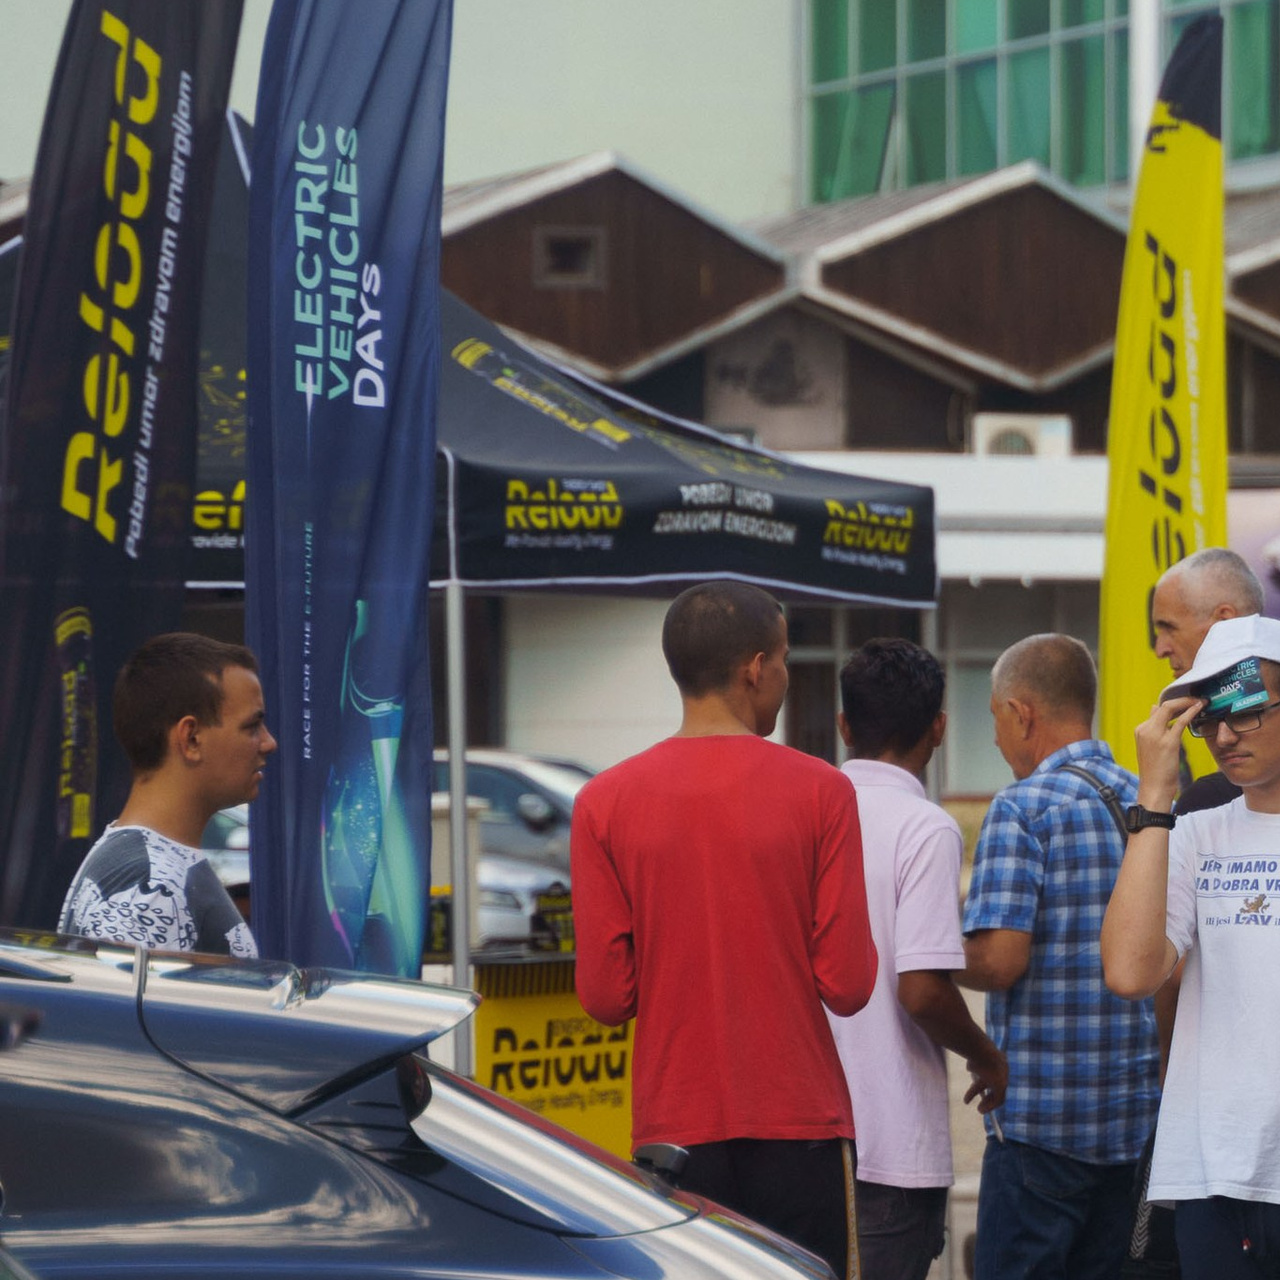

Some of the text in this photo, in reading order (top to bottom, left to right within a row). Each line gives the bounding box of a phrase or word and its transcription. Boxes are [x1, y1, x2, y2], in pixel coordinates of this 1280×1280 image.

[61, 10, 162, 543] Reload
[294, 120, 329, 396] ELECTRIC
[327, 125, 360, 401] VEHICLES
[353, 262, 386, 408] DAYS
[124, 451, 149, 559] Pobedi
[138, 366, 160, 450] umor
[149, 227, 179, 362] zdravom
[1139, 230, 1186, 650] eload
[303, 621, 312, 657] THE
[303, 663, 312, 702] FOR
[1220, 681, 1241, 695] DAYS
[303, 708, 312, 760] RACE
[1213, 877, 1259, 891] DOBRA
[1226, 860, 1278, 874] IMAMO
